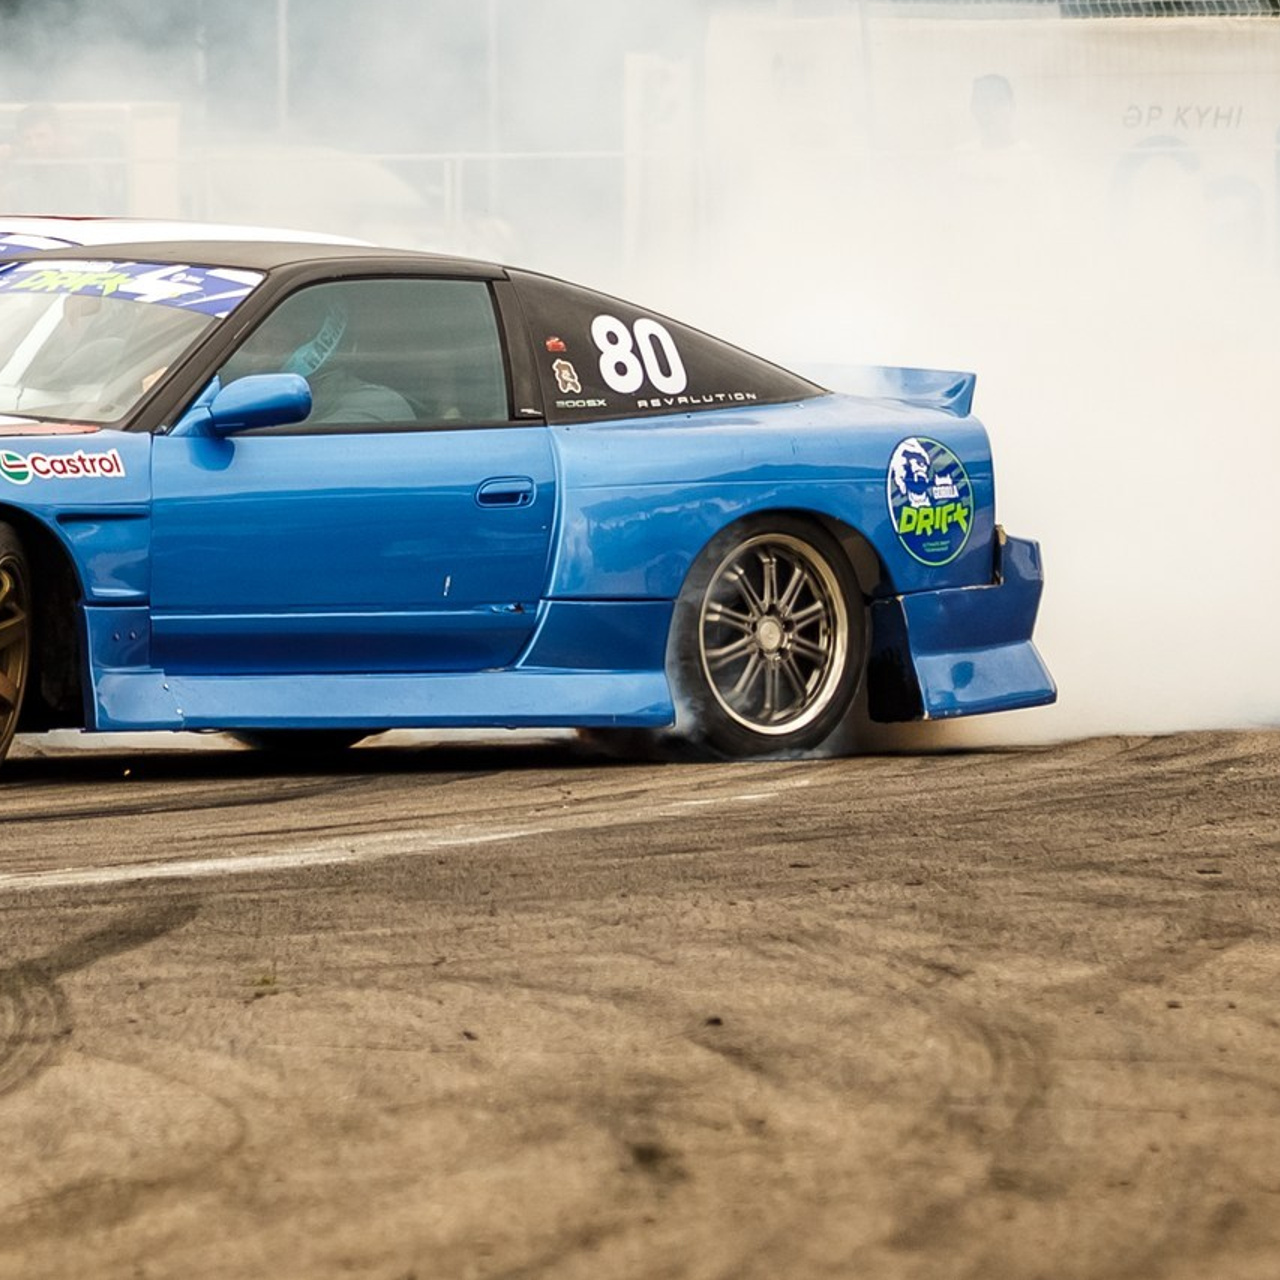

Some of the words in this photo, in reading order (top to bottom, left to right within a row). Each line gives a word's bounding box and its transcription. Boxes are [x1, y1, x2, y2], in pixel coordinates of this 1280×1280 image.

[590, 314, 688, 395] 80
[30, 453, 121, 476] Castrol
[898, 502, 969, 537] DRIFT
